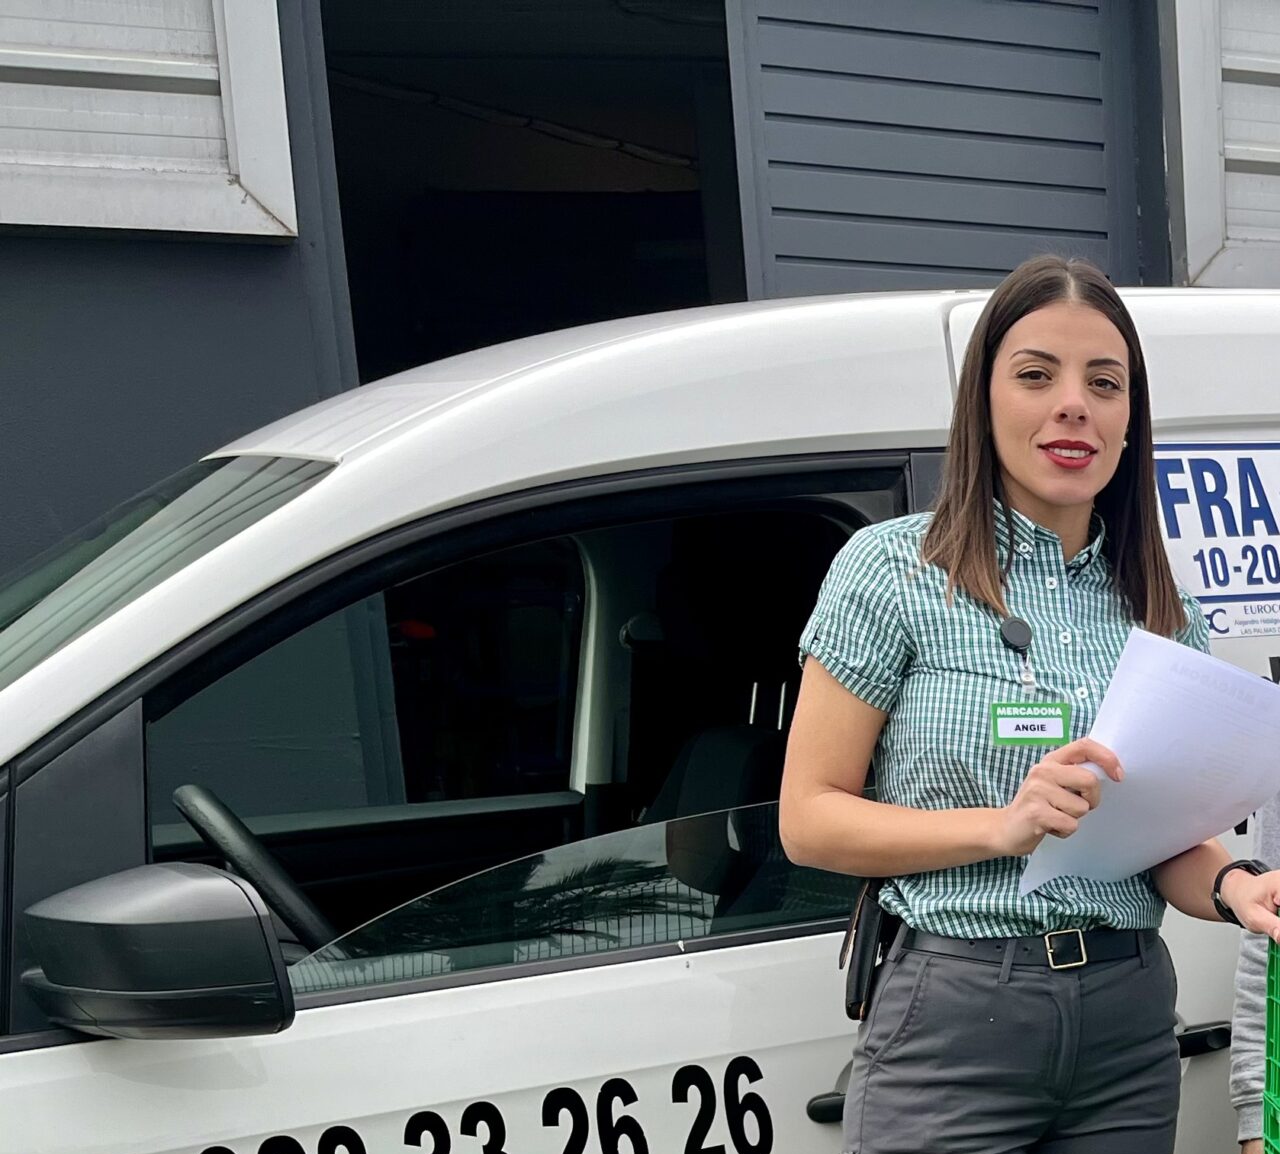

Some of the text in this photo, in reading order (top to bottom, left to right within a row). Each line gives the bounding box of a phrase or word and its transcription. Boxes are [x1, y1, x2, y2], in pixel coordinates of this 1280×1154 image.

[1253, 626, 1277, 634] PALMAS
[996, 707, 1062, 716] MERCADONA
[1014, 724, 1047, 732] ANGIE
